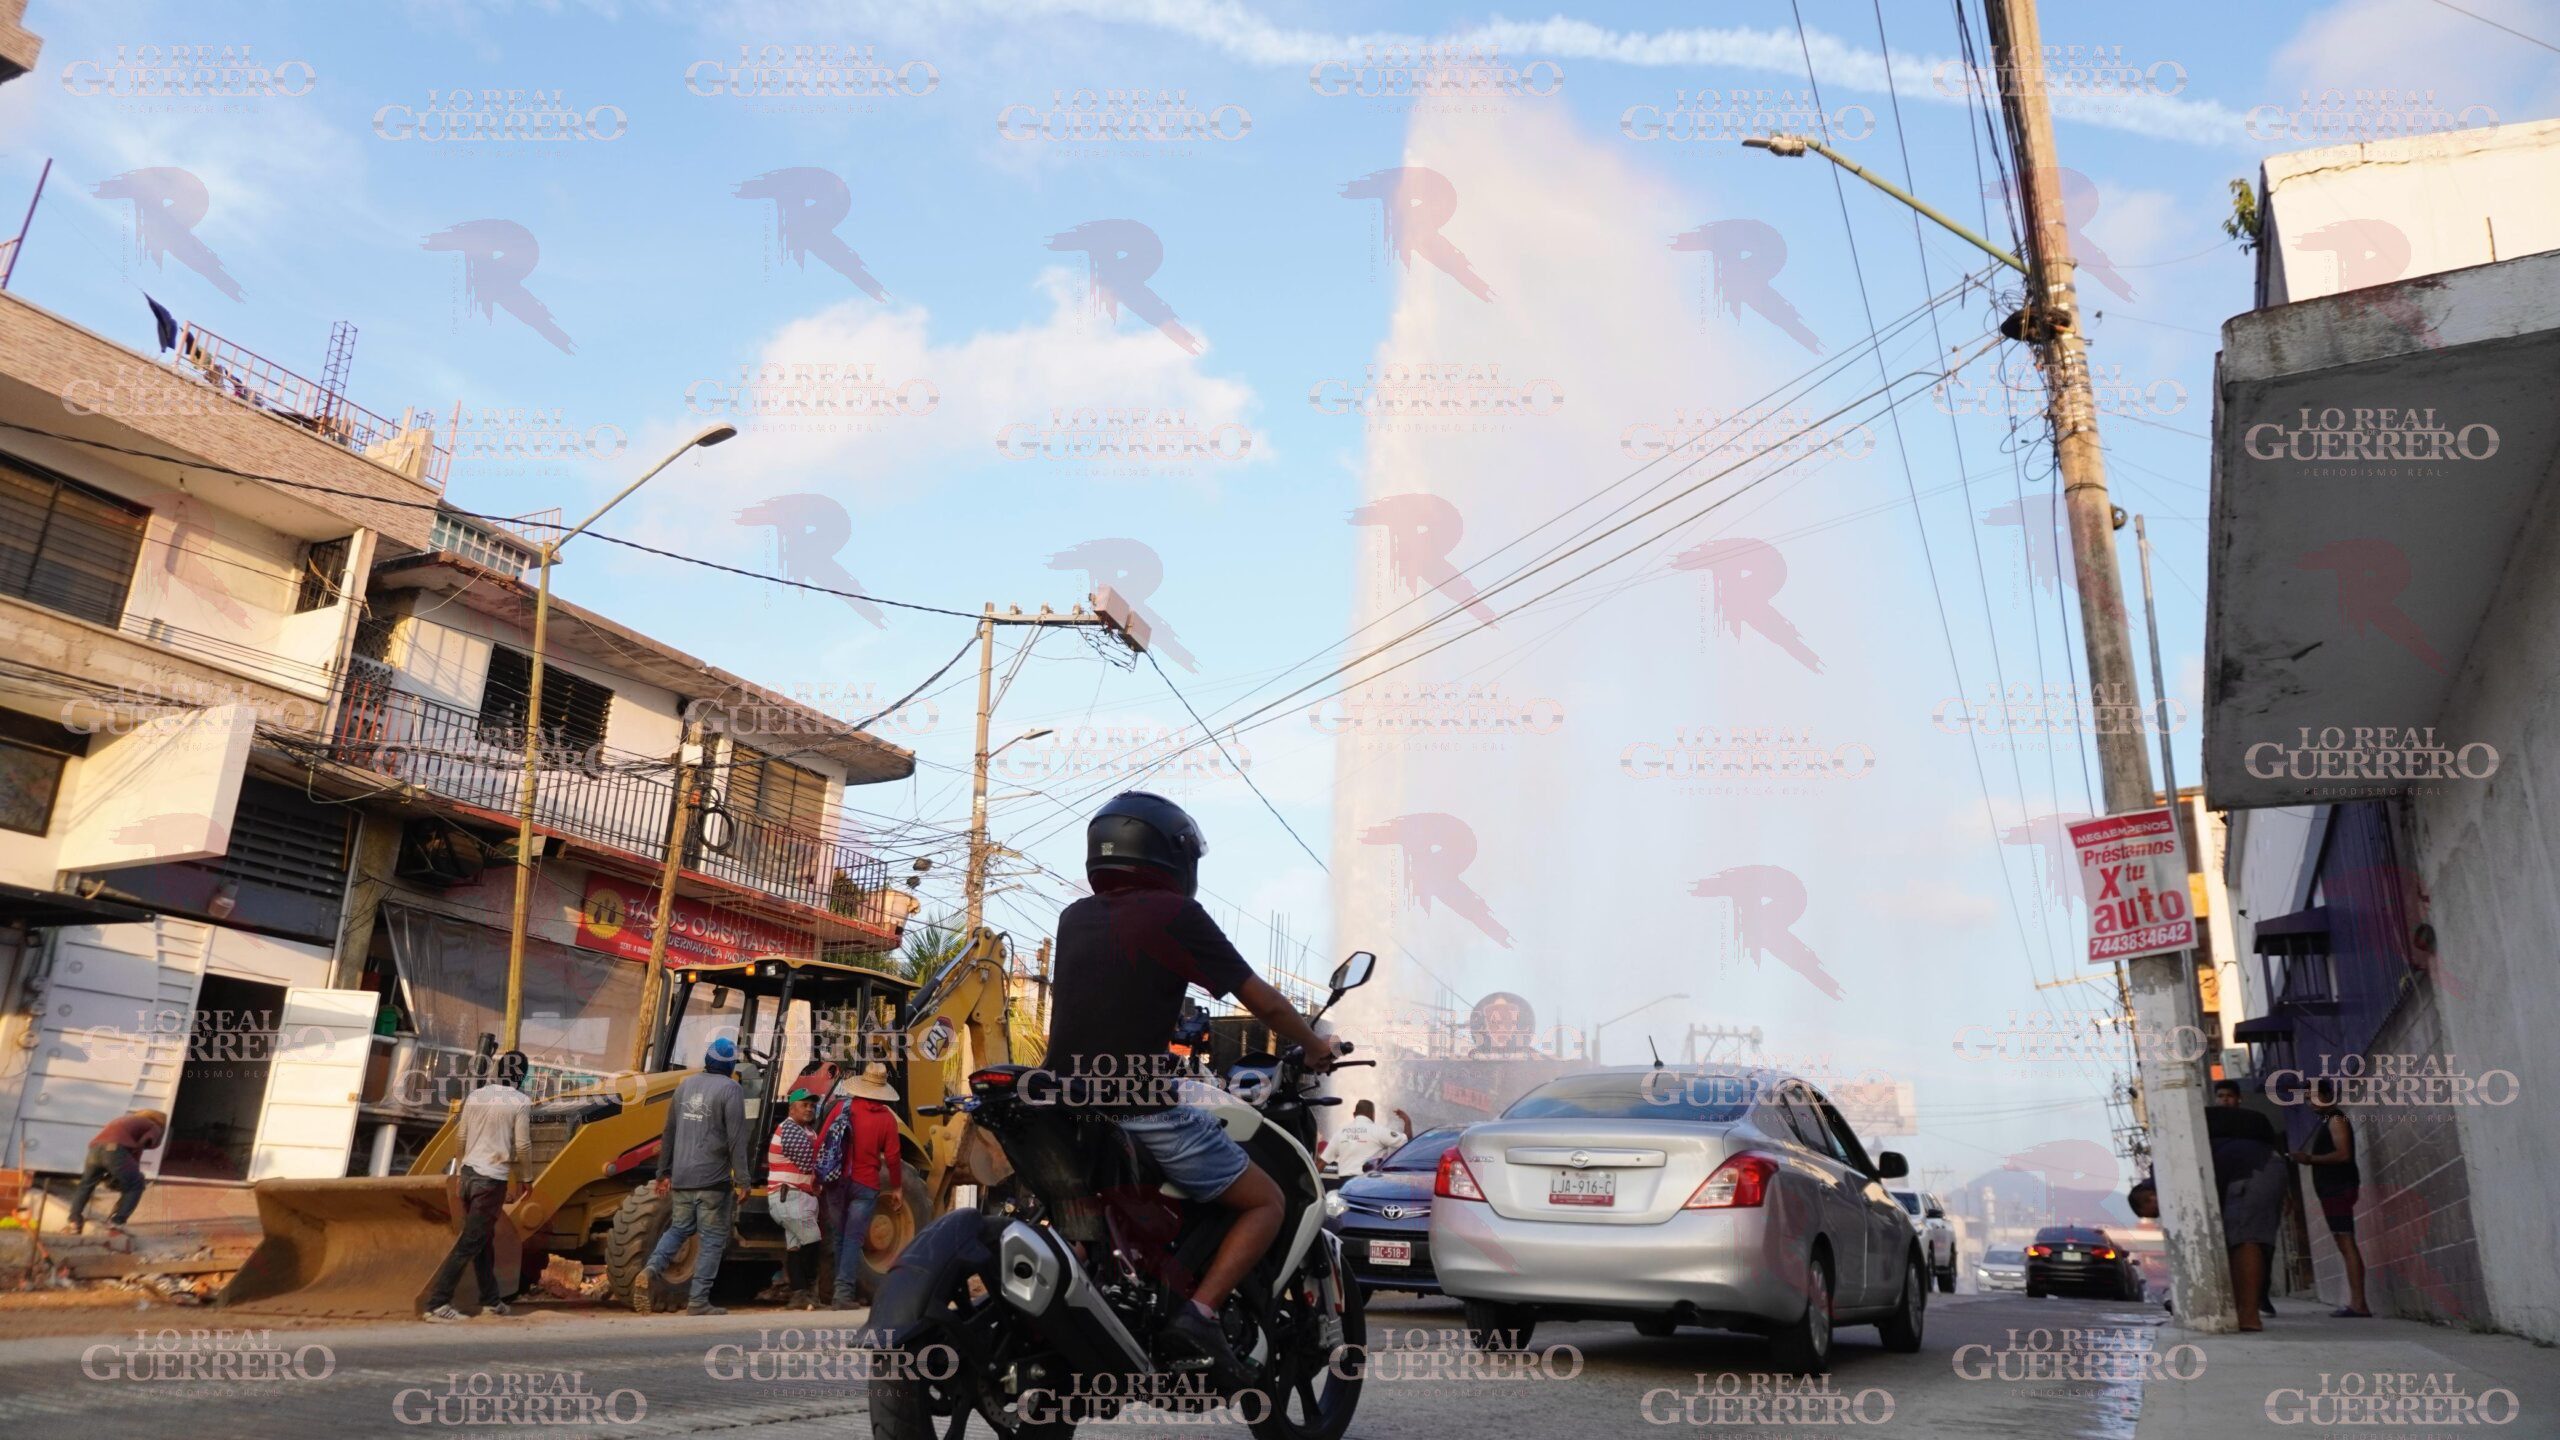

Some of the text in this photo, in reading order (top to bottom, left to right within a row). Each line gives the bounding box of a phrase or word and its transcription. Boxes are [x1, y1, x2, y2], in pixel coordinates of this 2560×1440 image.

[2084, 840, 2175, 867] Préstamos
[2126, 862, 2145, 882] tu
[2093, 887, 2186, 935] auto
[668, 934, 722, 958] UERNAVACA
[1551, 1179, 1611, 1195] LJA-916-C
[1371, 1246, 1409, 1260] HAC-518-J
